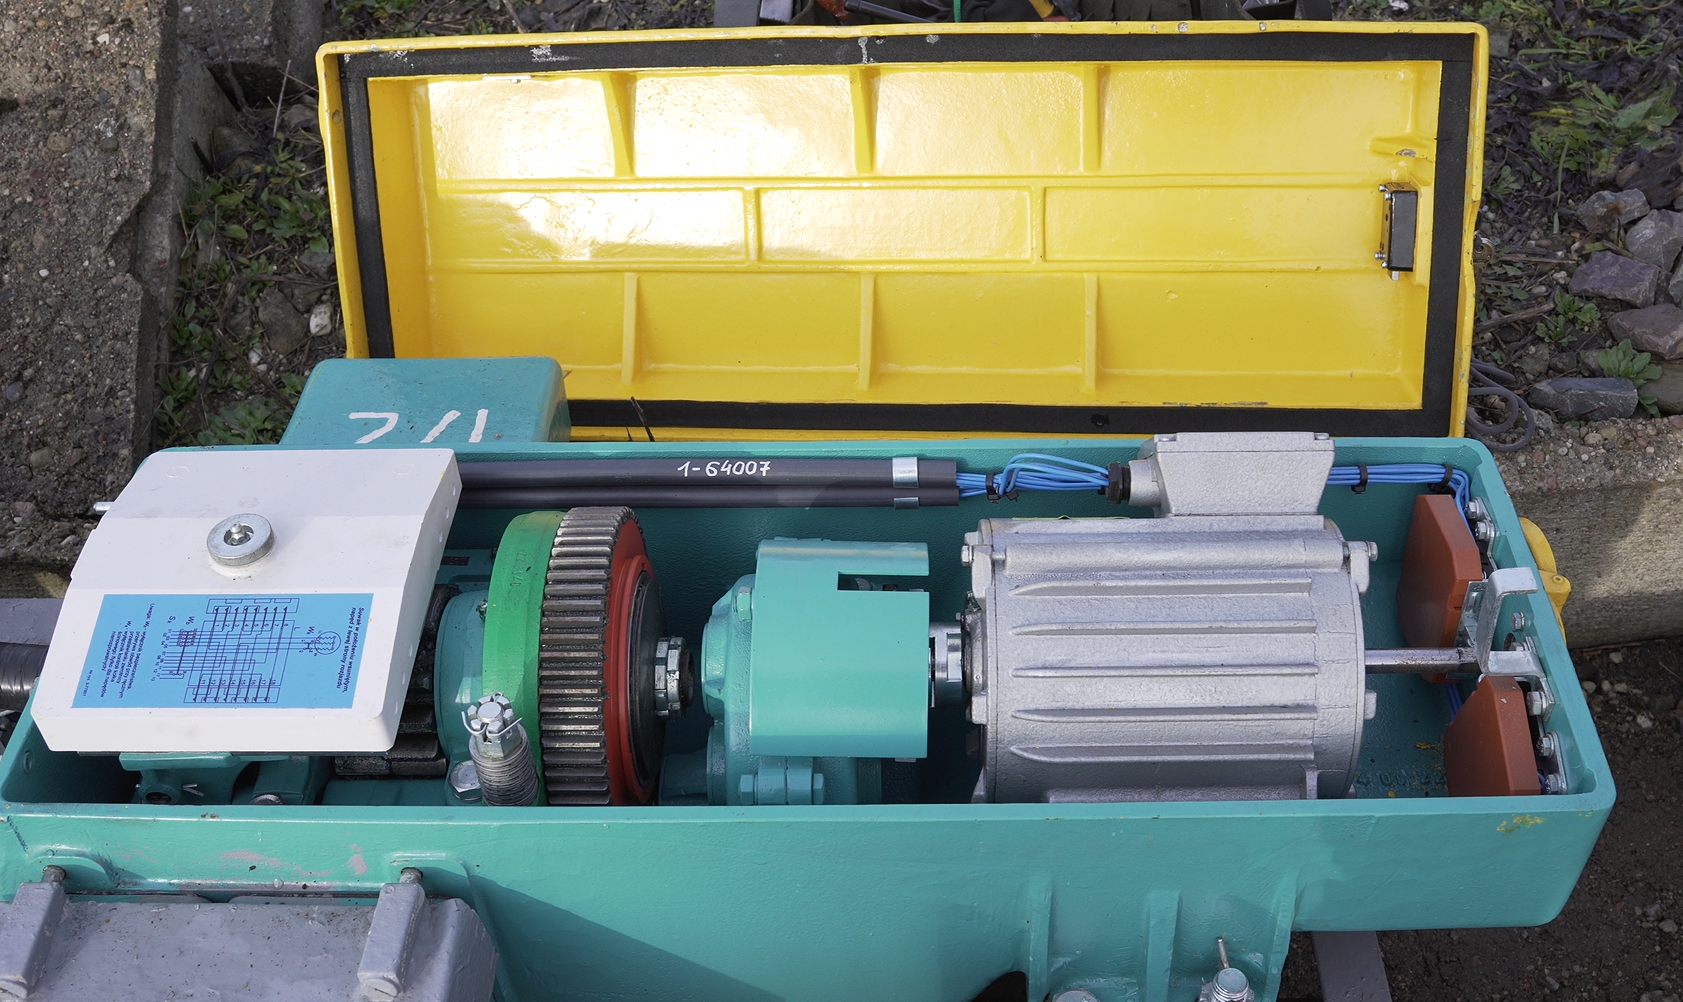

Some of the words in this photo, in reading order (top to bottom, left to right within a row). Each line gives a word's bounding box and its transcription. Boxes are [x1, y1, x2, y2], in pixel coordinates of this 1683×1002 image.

[677, 460, 771, 477] 1-64007
[356, 607, 364, 625] Suwak
[344, 630, 353, 644] lewej
[349, 632, 358, 660] położeniu
[340, 645, 349, 663] strony
[336, 664, 345, 689] rozjazdu
[342, 661, 353, 693] wsuniętym,
